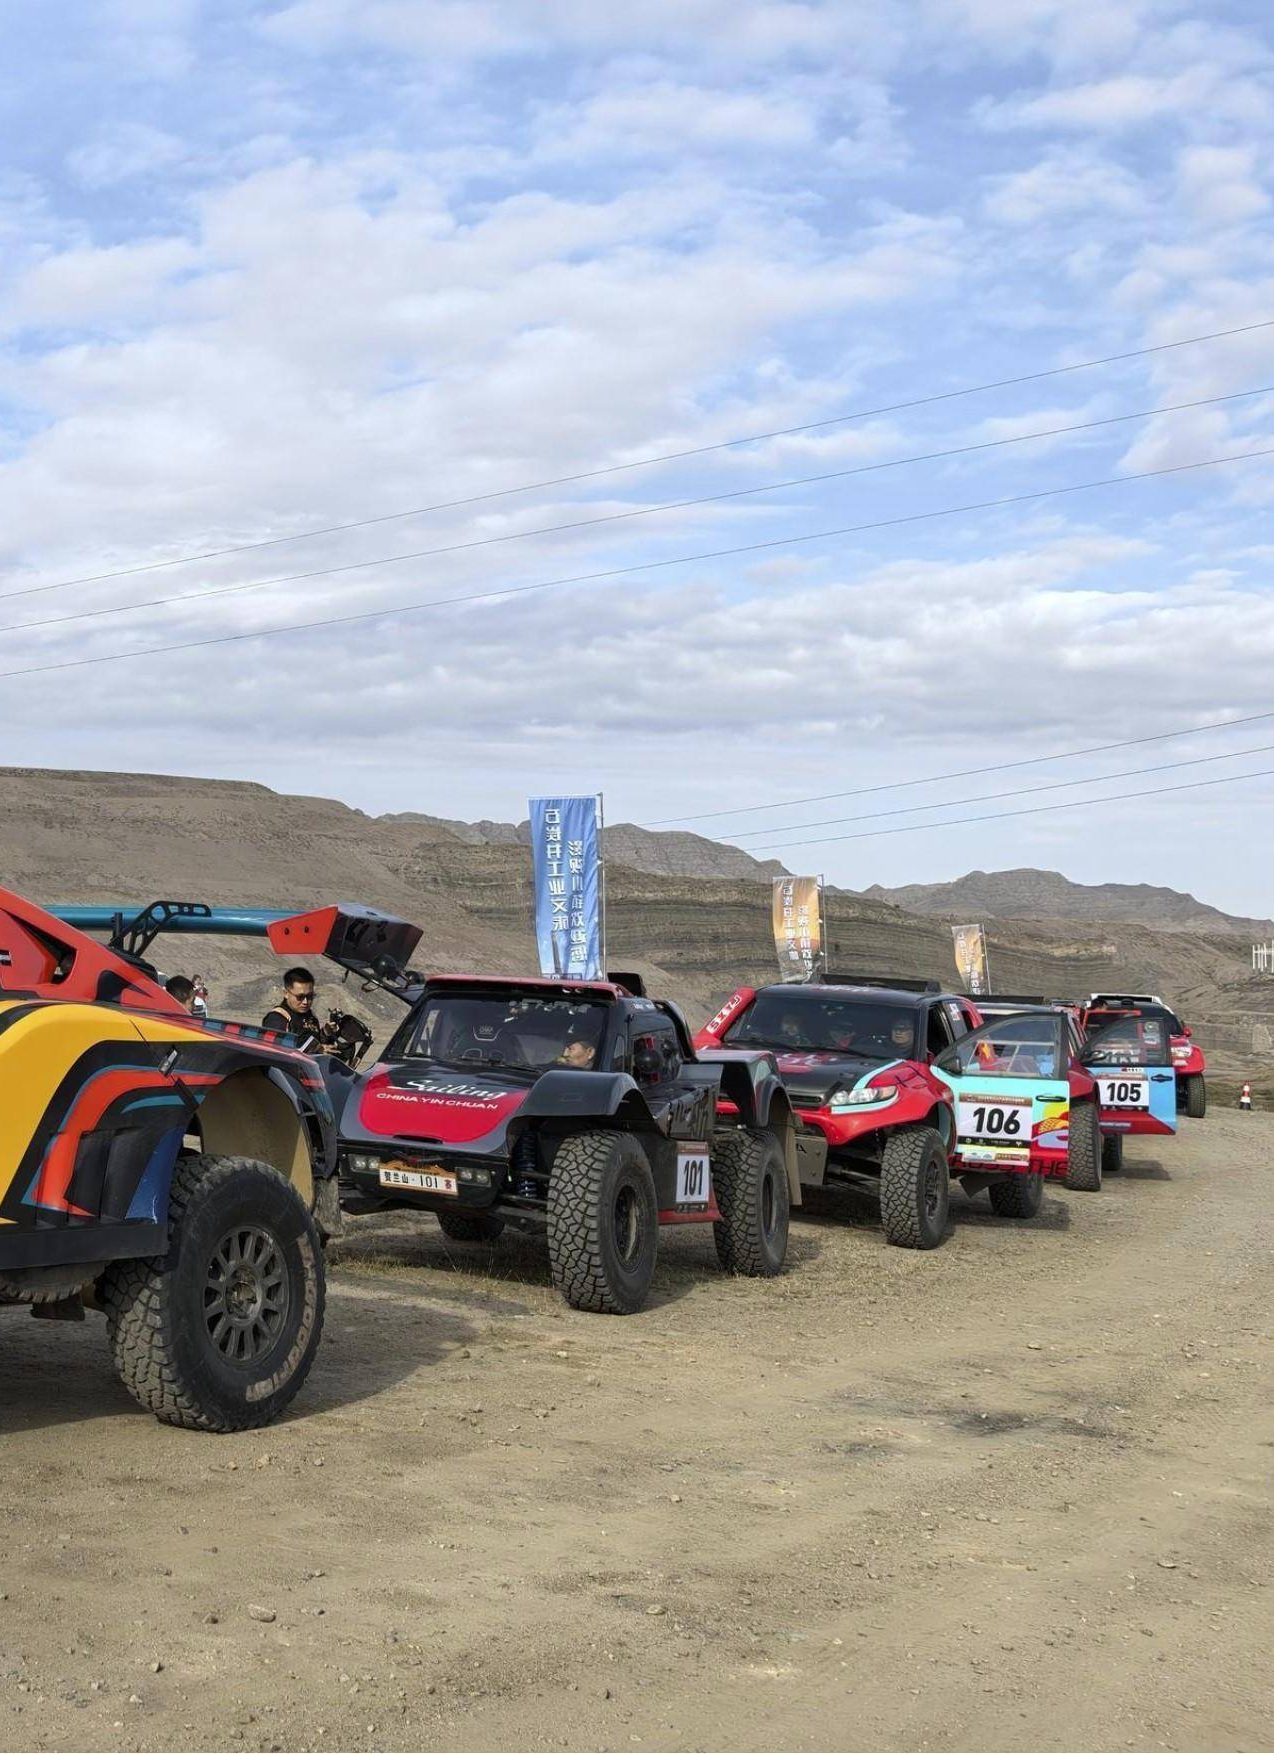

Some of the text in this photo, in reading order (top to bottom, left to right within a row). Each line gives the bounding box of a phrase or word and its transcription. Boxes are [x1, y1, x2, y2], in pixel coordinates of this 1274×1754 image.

[376, 1093, 418, 1102] CHINA
[1107, 1083, 1142, 1103] 105
[973, 1107, 1021, 1135] 106
[684, 1160, 704, 1196] 101
